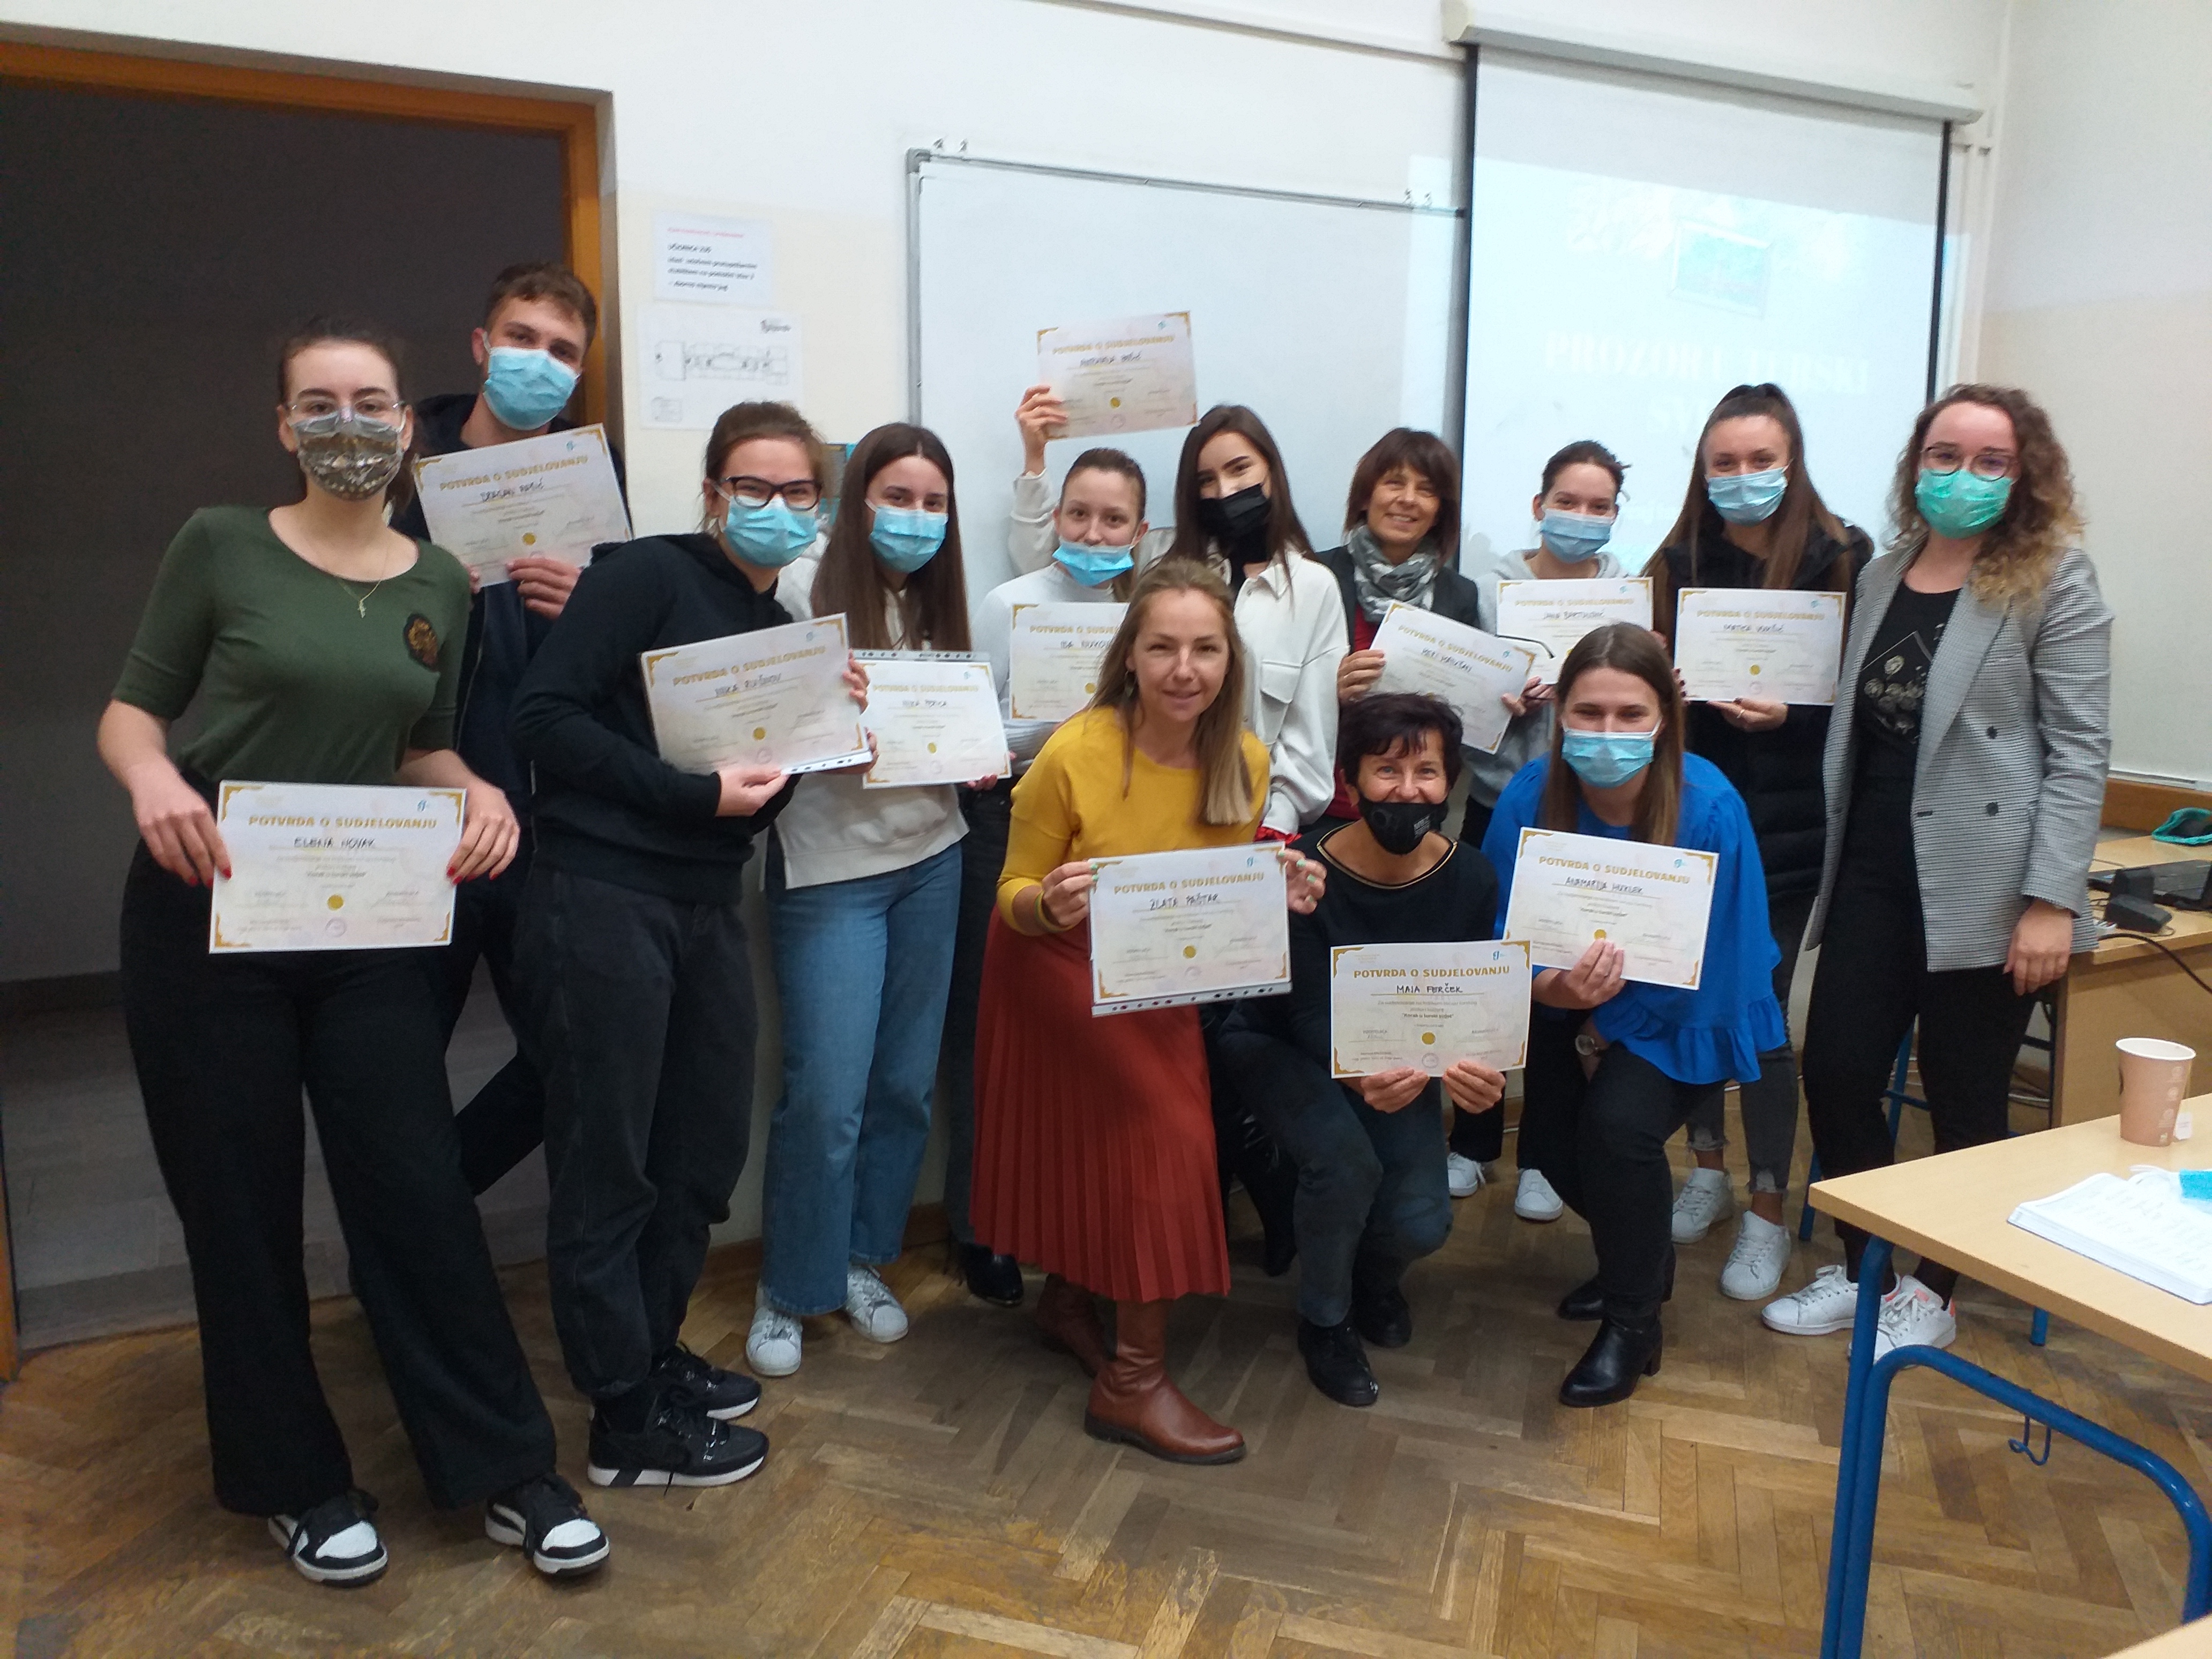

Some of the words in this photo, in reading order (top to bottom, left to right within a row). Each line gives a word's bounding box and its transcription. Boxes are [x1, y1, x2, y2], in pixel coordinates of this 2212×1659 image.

[249, 816, 313, 826] POTVRDA
[321, 817, 330, 827] O
[335, 817, 437, 829] SUDJELOVANJU
[1539, 856, 1588, 871] POTVRDA
[1593, 863, 1601, 871] O
[1604, 865, 1691, 884] SUDJELOVANJU
[1114, 881, 1165, 895] POTVRDA
[1169, 880, 1177, 889] O
[1182, 872, 1265, 888] SUDJELOVANJU
[1354, 969, 1407, 978] POTVRDA
[1410, 969, 1418, 977] O
[1423, 966, 1509, 977] SUDJELOVANJU
